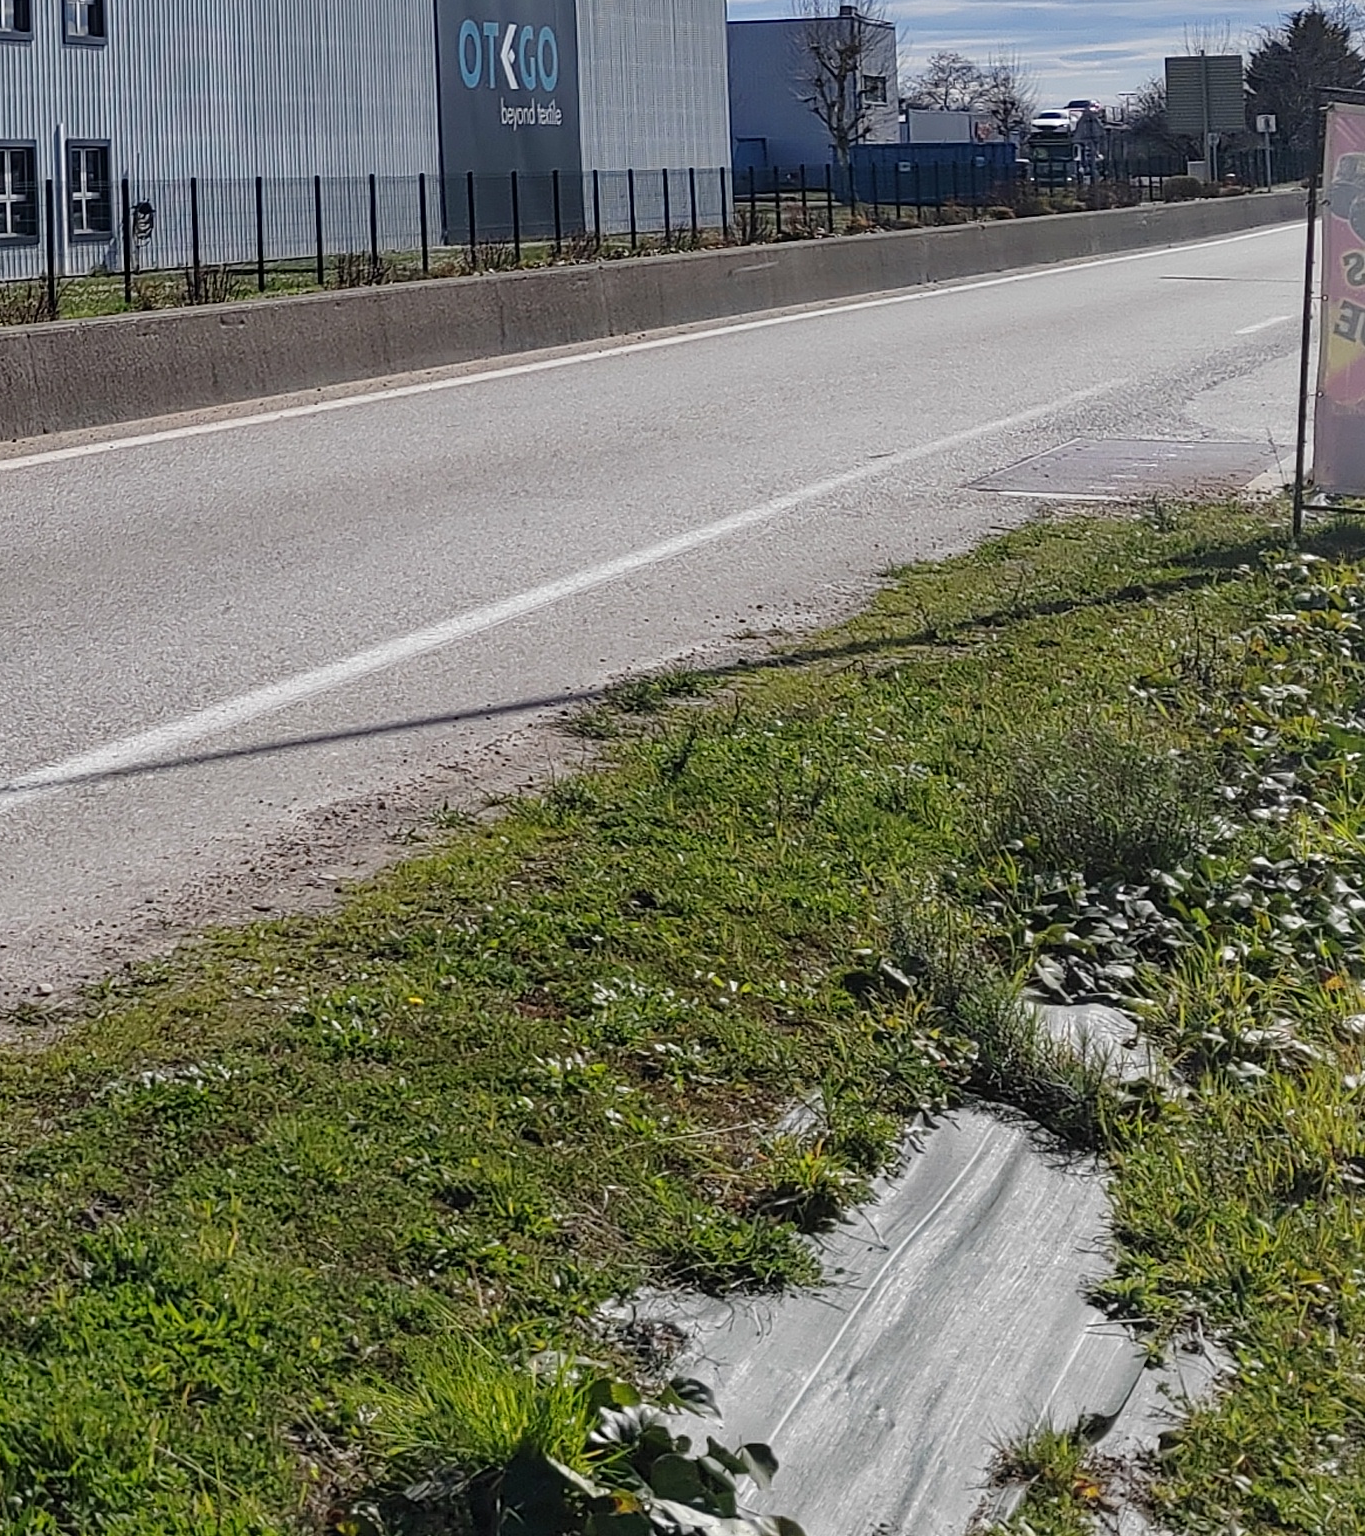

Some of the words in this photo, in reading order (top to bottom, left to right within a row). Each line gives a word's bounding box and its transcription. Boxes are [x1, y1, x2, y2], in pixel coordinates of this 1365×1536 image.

[459, 19, 559, 92] OTEGO
[500, 97, 535, 131] beyond
[537, 99, 563, 125] textile
